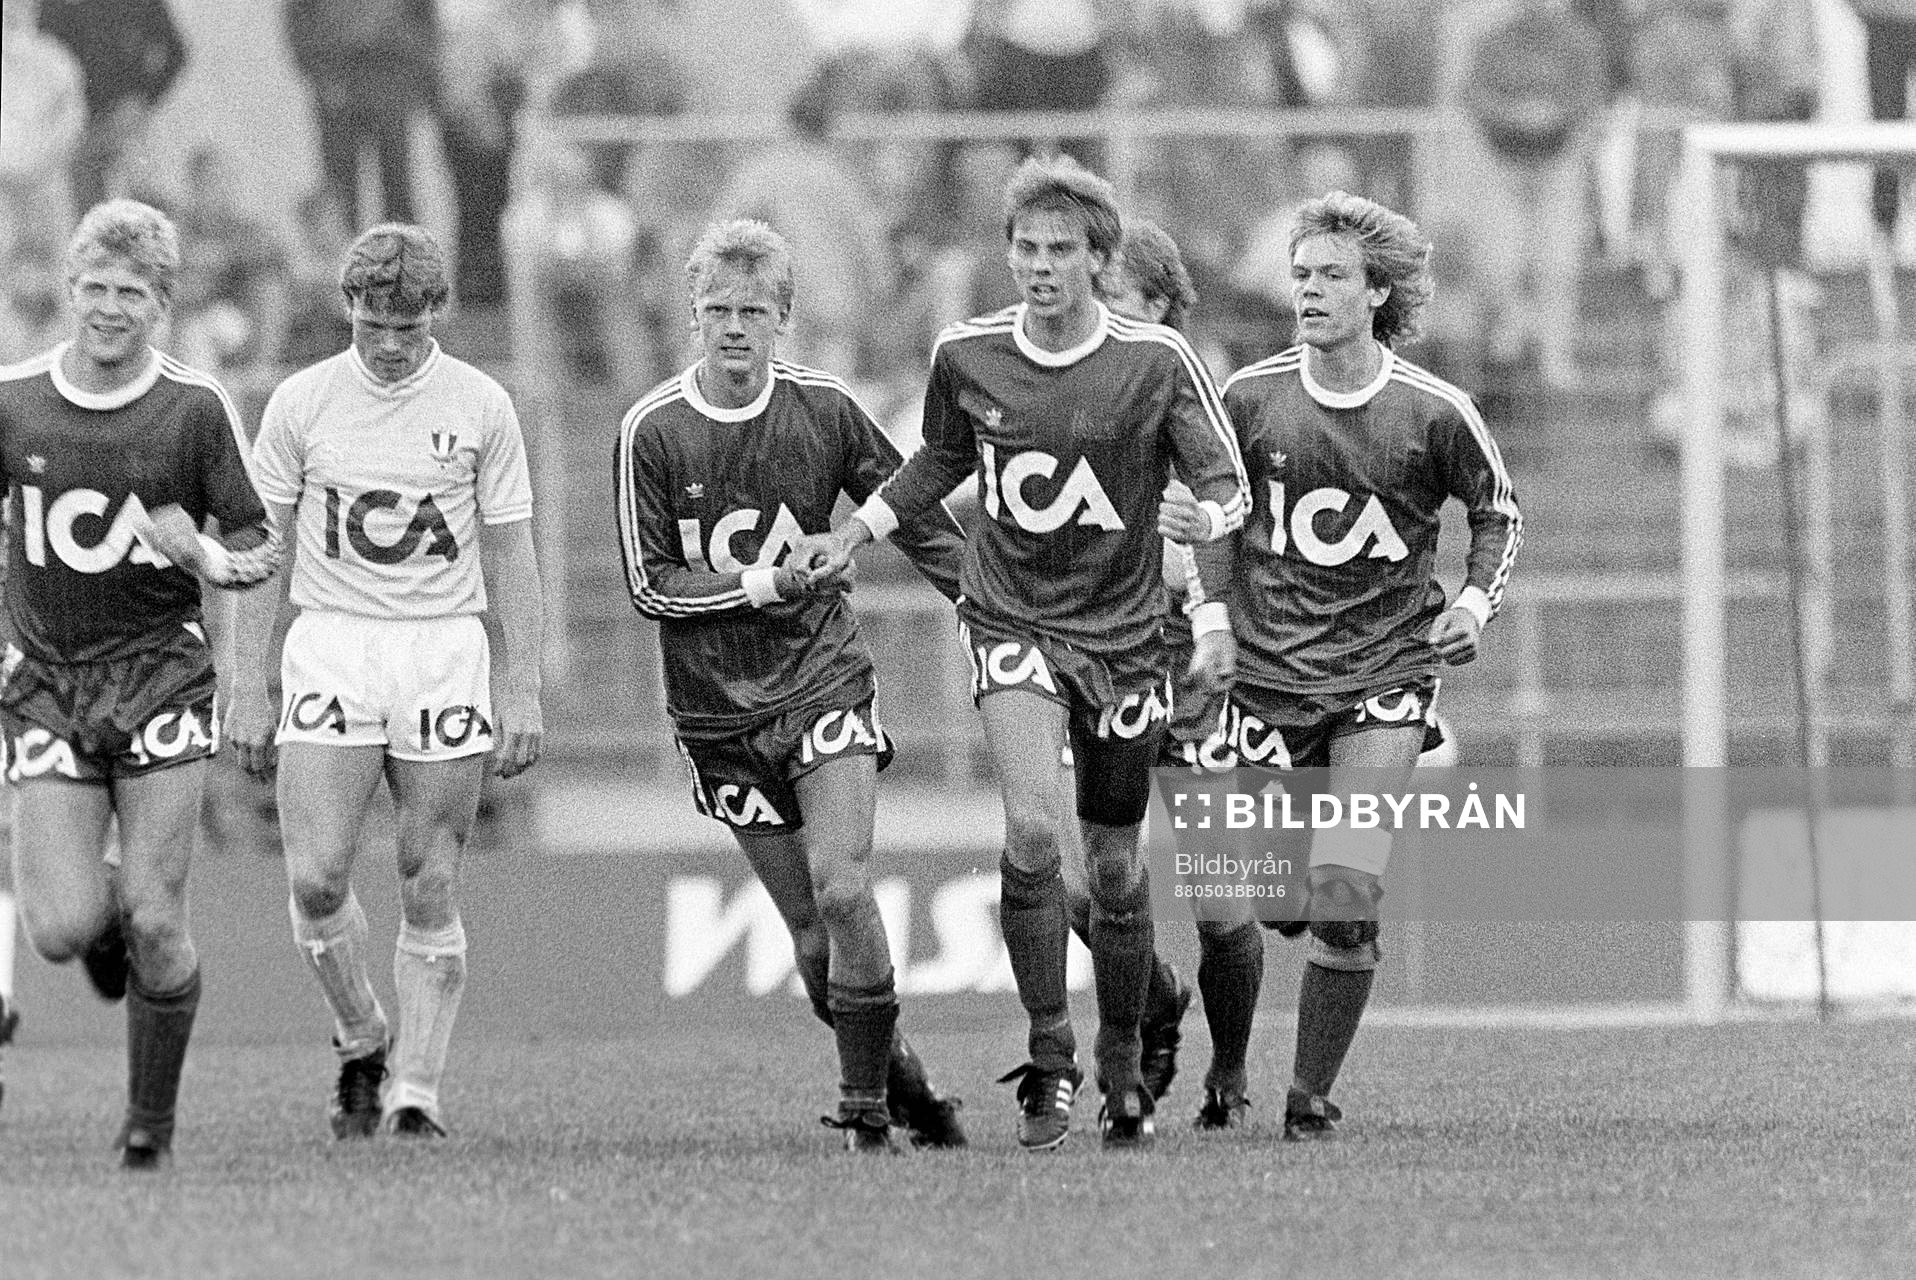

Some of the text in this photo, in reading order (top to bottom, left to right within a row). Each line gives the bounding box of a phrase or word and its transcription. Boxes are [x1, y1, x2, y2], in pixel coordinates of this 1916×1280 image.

[982, 441, 1126, 534] ICA
[22, 485, 173, 574] ICA
[325, 487, 460, 565] ICA
[1268, 480, 1410, 567] ICA
[977, 642, 1057, 694] ICA
[130, 706, 212, 765] ICA
[283, 692, 346, 734] ICA
[420, 704, 492, 752] ICA
[802, 709, 877, 764] ICA
[1097, 686, 1168, 739] ICA
[1227, 704, 1294, 771] ICA
[8, 728, 79, 781] ICA
[709, 784, 785, 826] ICA
